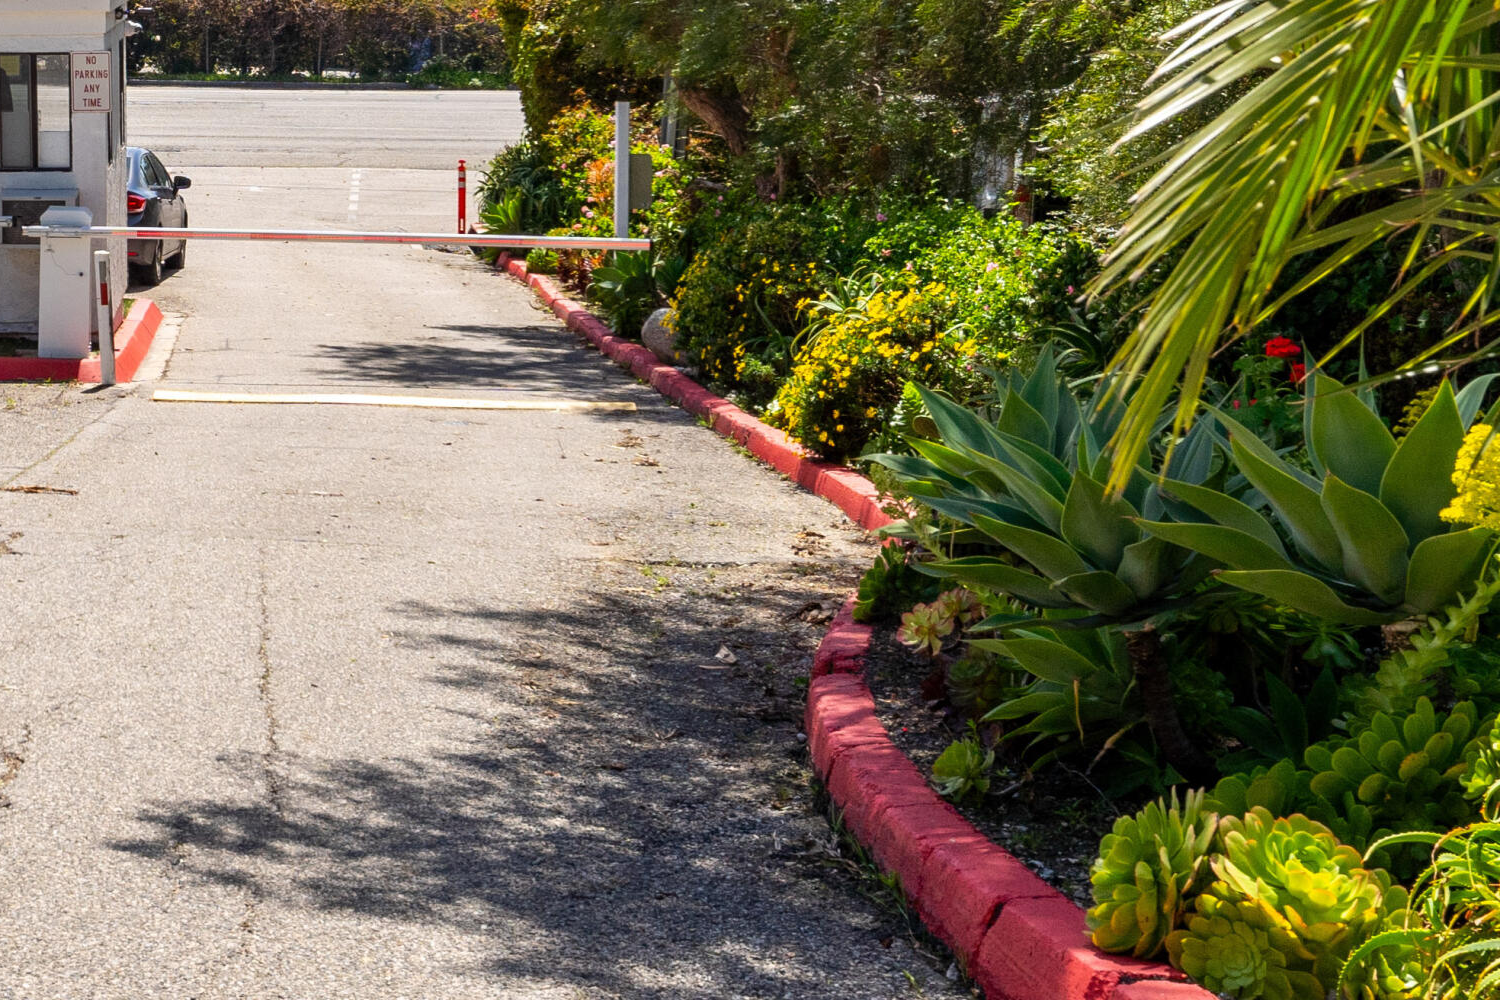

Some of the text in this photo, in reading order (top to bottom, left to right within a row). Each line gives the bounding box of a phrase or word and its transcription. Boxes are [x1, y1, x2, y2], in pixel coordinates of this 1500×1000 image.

[85, 56, 97, 65] NO
[74, 70, 108, 79] PARKING
[84, 84, 100, 93] ANY
[82, 98, 102, 107] TIME
